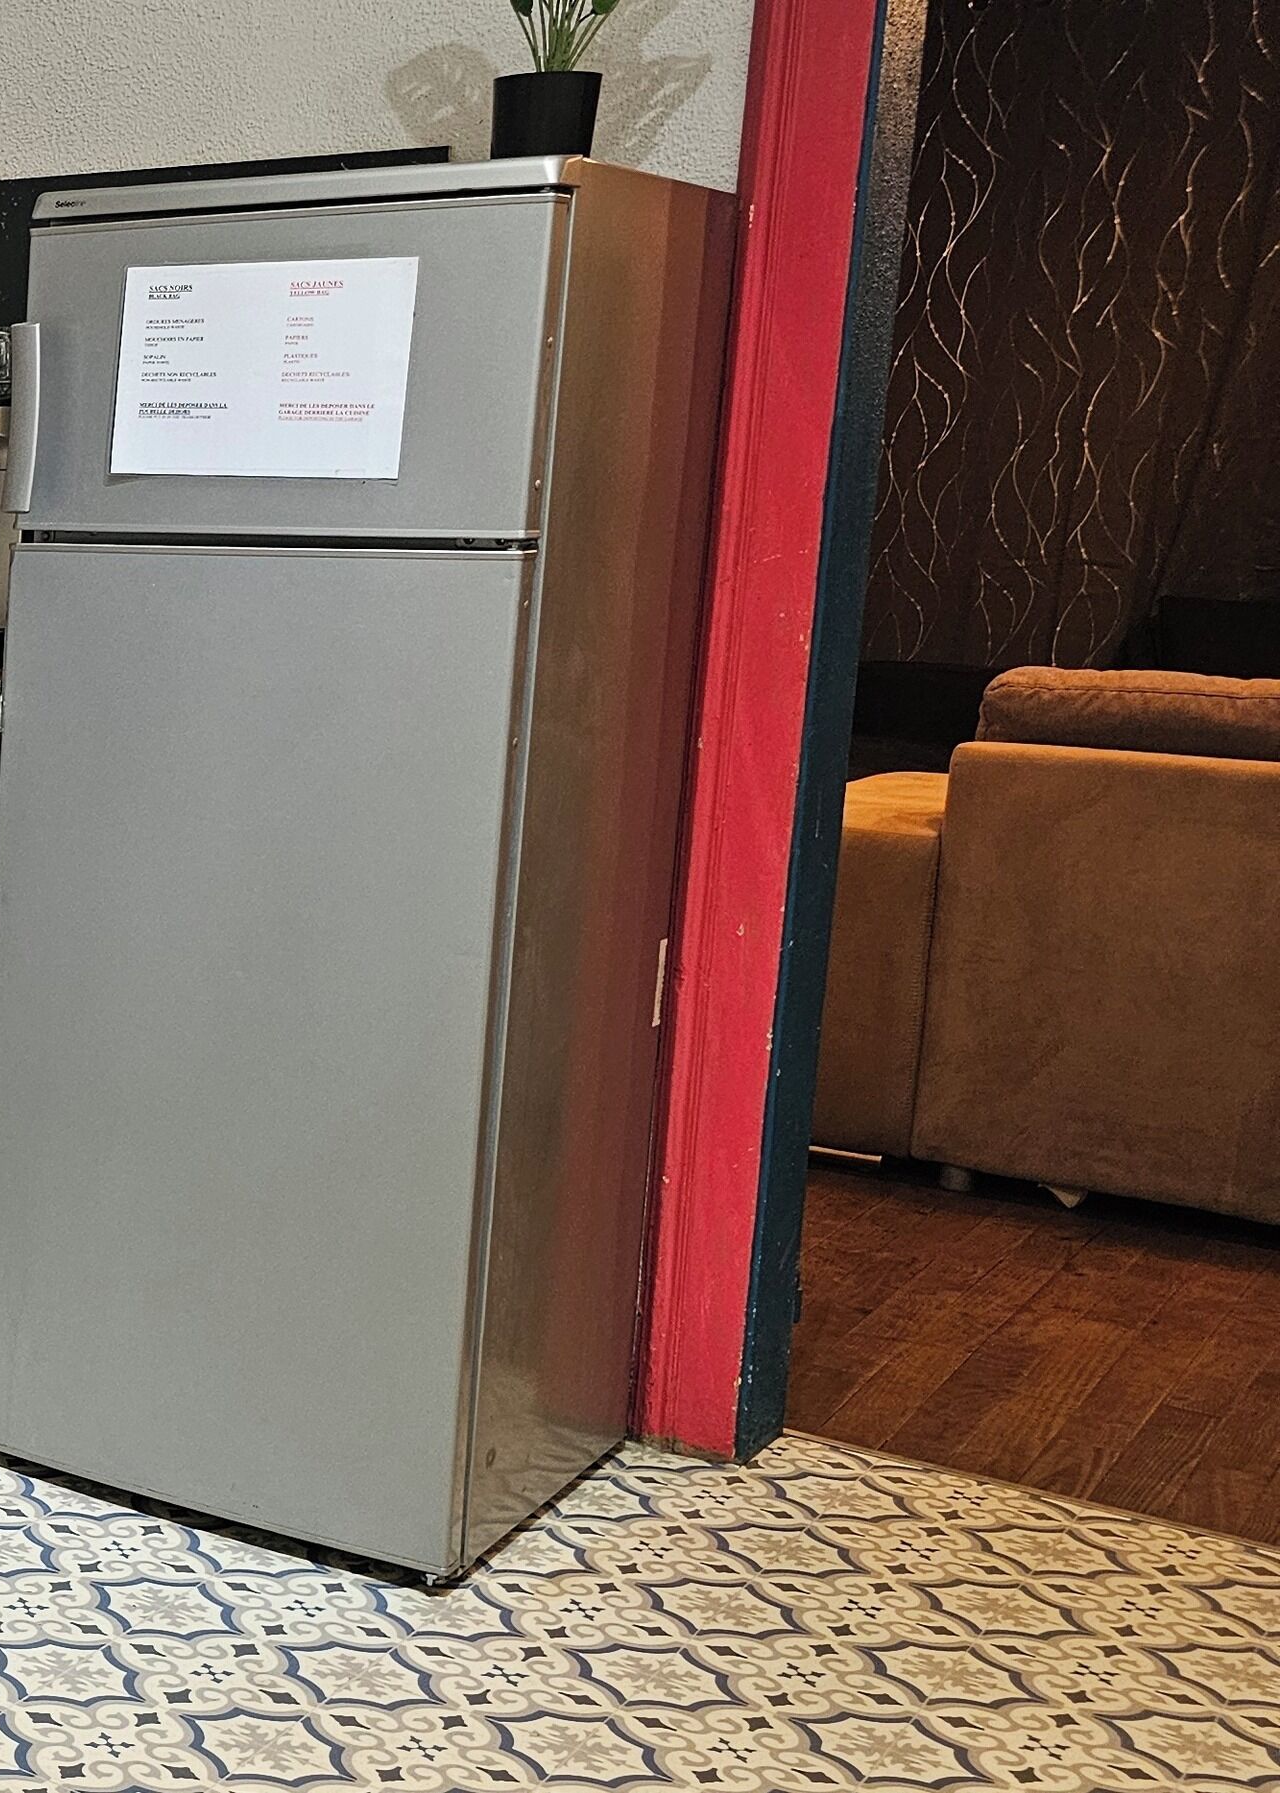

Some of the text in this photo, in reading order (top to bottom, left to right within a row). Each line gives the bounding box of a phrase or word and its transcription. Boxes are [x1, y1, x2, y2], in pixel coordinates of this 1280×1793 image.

[149, 284, 193, 293] SACS NOIRS
[290, 280, 344, 290] SACS JAUNES
